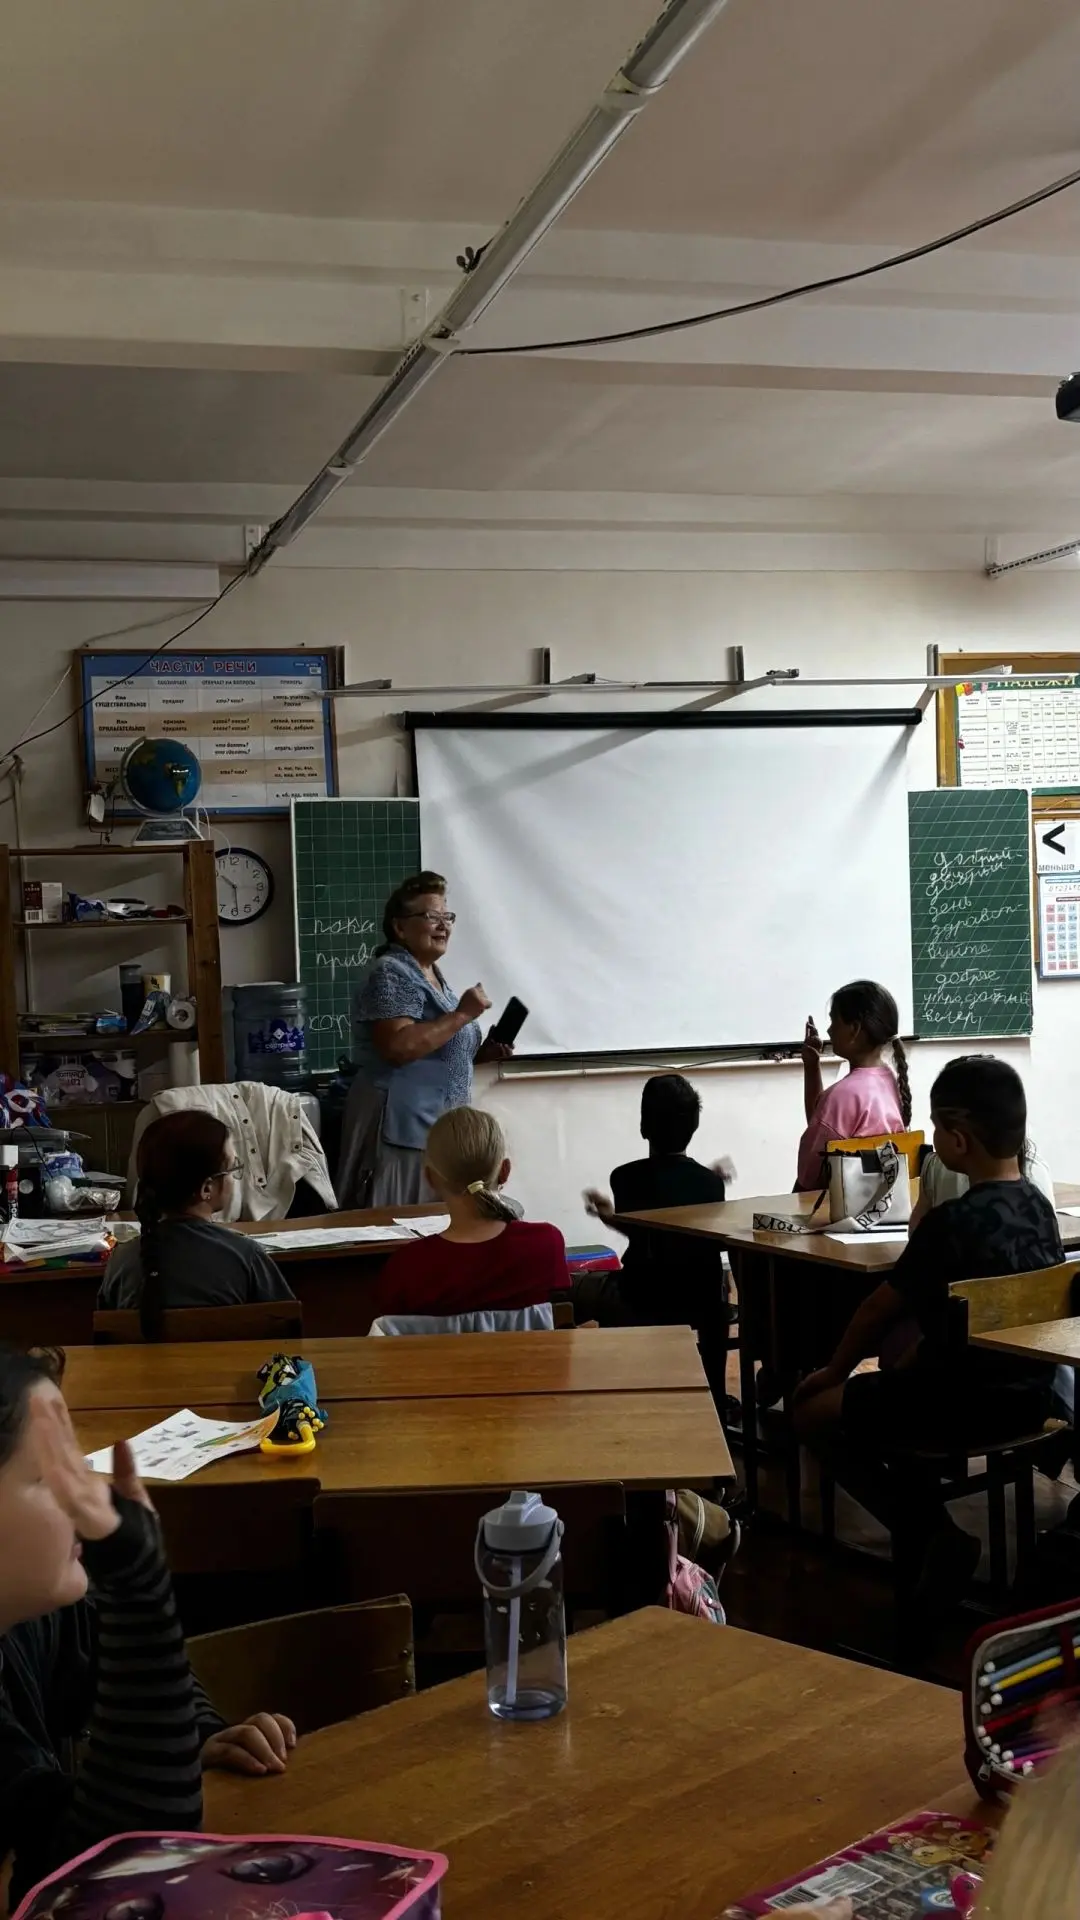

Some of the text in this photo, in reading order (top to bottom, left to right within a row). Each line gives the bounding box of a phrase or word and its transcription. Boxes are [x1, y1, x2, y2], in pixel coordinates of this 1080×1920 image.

[150, 660, 258, 673] ЧАСТИ РЕЧИ
[229, 856, 240, 866] 12
[1038, 863, 1076, 872] меньше
[252, 869, 261, 879] 2
[256, 882, 264, 891] 3
[252, 895, 260, 905] 4
[219, 903, 227, 913] 7
[230, 907, 239, 917] 6
[243, 903, 252, 913] 5
[314, 916, 376, 935] пока
[935, 968, 1001, 994] доброе
